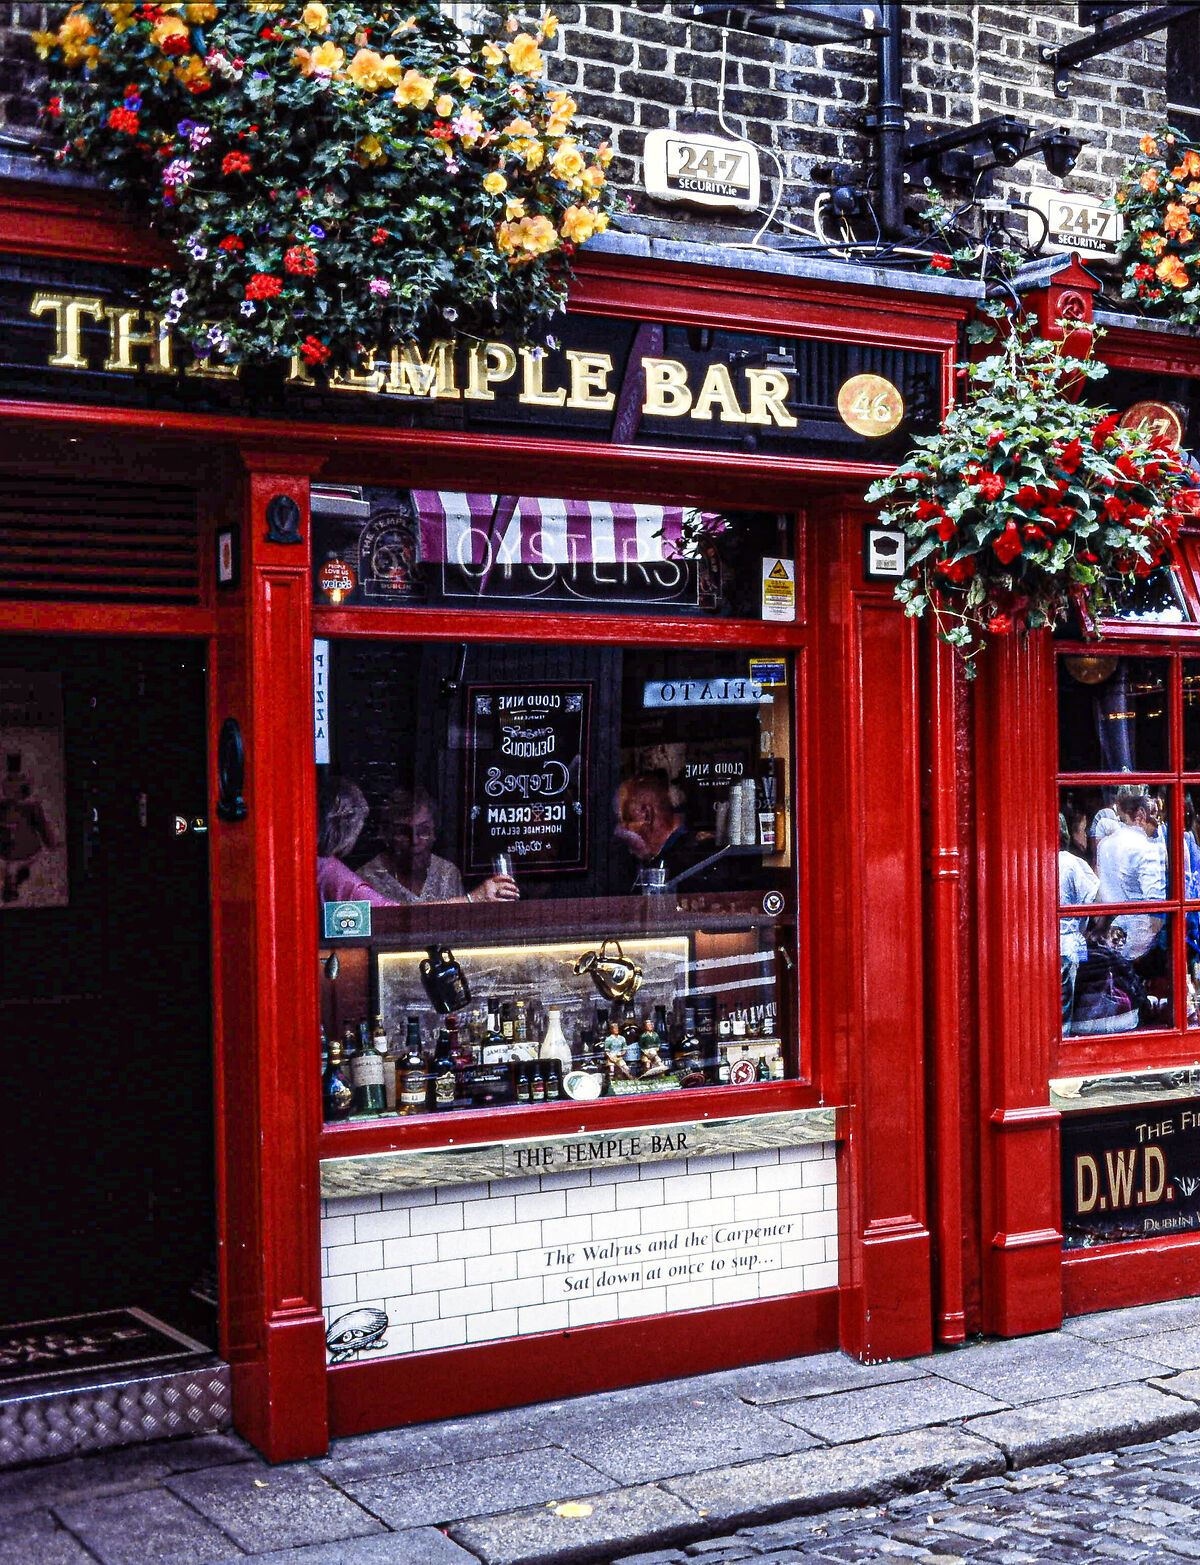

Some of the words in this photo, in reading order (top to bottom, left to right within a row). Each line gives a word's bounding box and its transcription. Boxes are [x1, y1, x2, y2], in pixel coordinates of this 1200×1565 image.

[678, 178, 738, 197] SECURITY.ie
[1058, 234, 1107, 250] SECURITY.ie
[641, 357, 798, 428] BAR
[851, 389, 892, 423] 46
[362, 533, 375, 557] THE
[457, 528, 681, 587] OYSTERS
[322, 579, 344, 590] yelp
[1136, 1120, 1174, 1143] THE
[514, 1147, 553, 1168] THE
[563, 1138, 641, 1163] TEMPLE
[651, 1132, 688, 1153] BAR
[1076, 1146, 1173, 1213] D.W.D.
[1144, 1216, 1193, 1231] DUBLIN
[544, 1250, 575, 1267] The
[582, 1243, 641, 1261] Walrus
[648, 1234, 678, 1252] and
[685, 1232, 708, 1248] the
[715, 1223, 795, 1243] Carpenter
[563, 1276, 590, 1292] Sat
[596, 1271, 640, 1288] down
[646, 1269, 661, 1281] at
[668, 1261, 705, 1278] once
[711, 1257, 725, 1271] to
